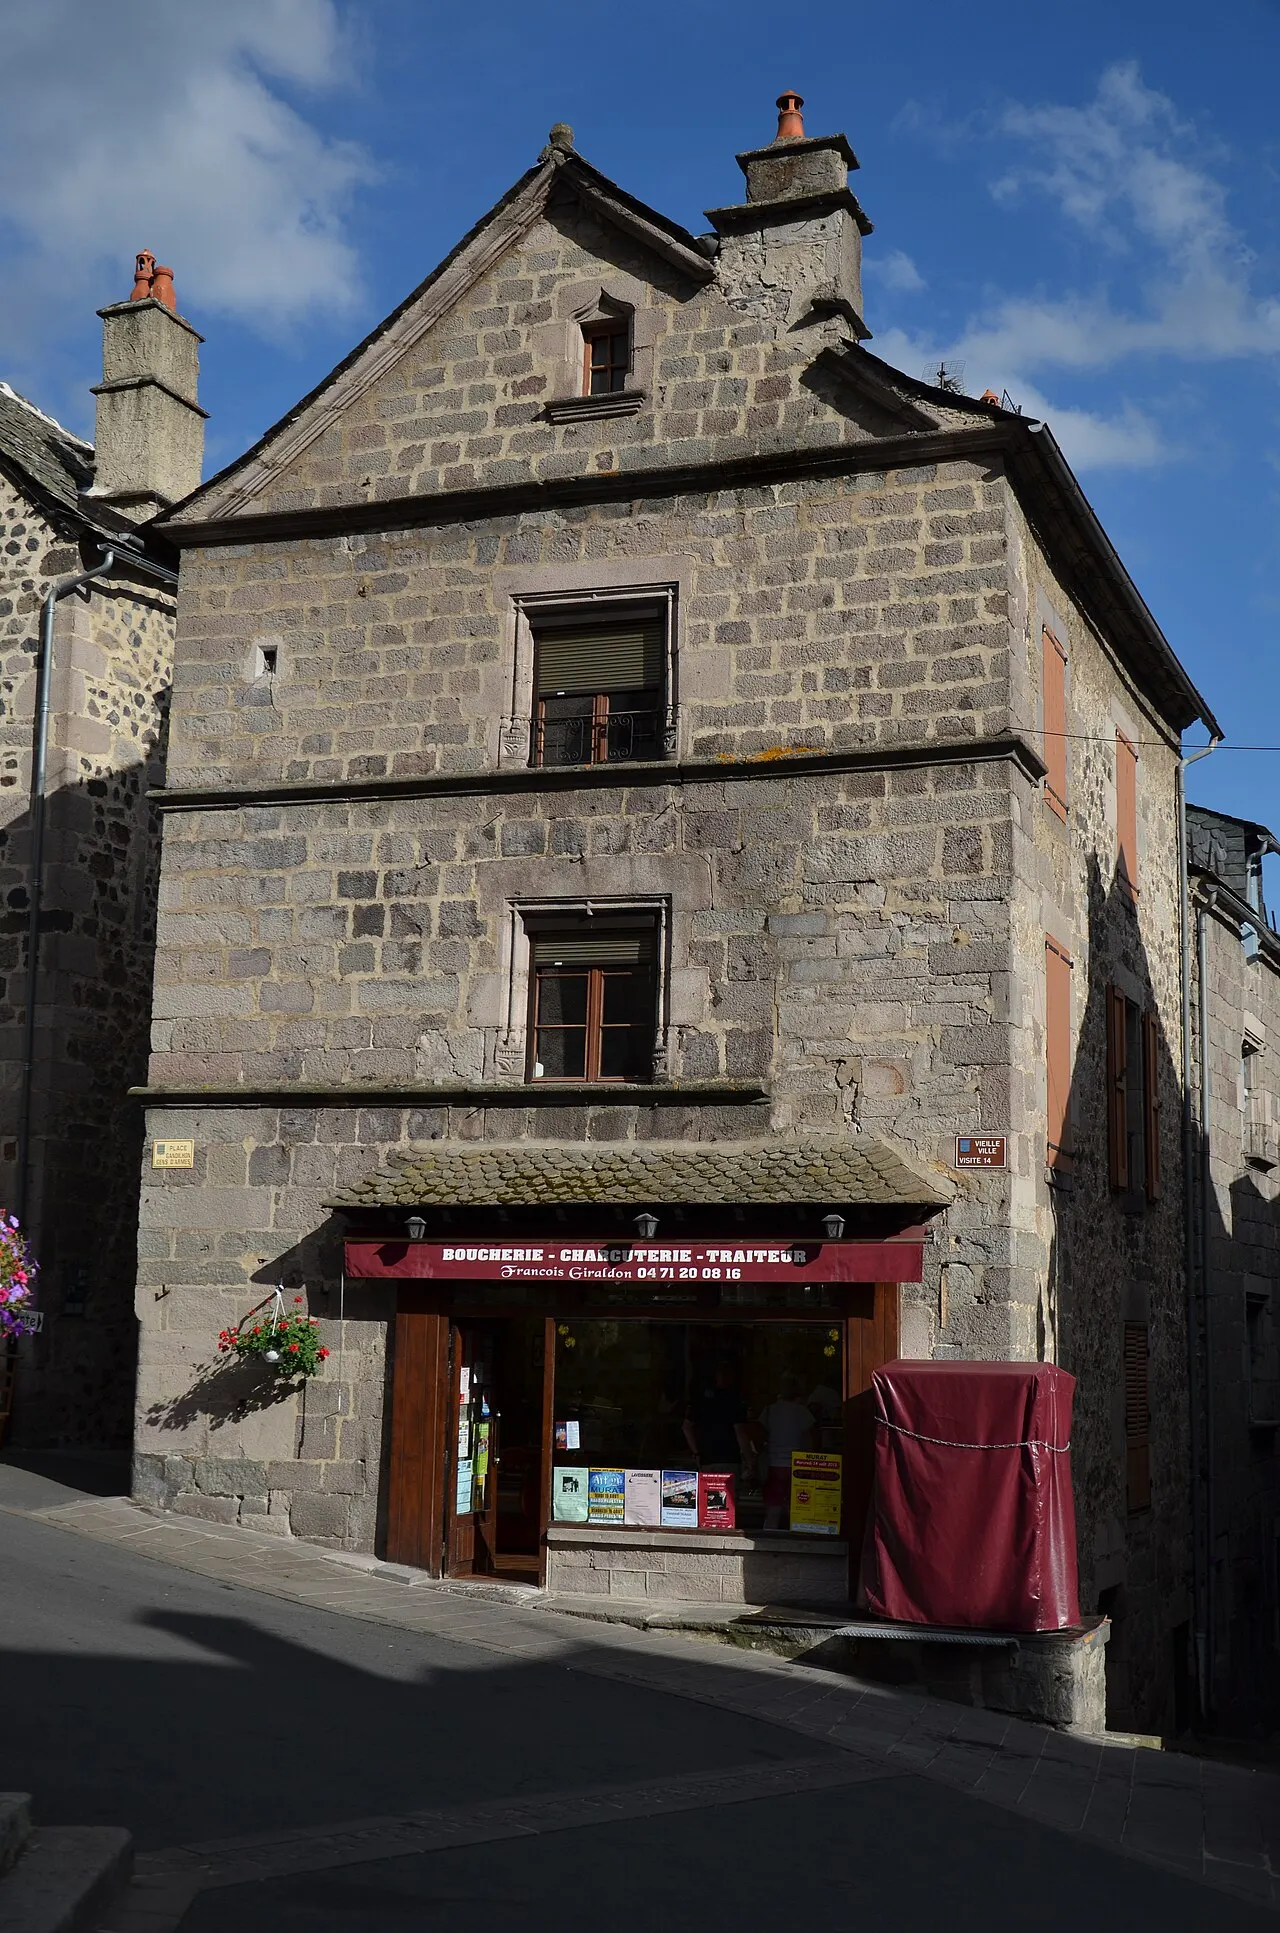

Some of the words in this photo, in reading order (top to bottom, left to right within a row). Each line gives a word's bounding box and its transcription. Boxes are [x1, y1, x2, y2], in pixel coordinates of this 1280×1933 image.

[443, 1248, 543, 1261] BOUCHERIE
[560, 1249, 692, 1262] CHARCUTERIE
[706, 1249, 806, 1263] TRAITEUR
[500, 1265, 564, 1278] Francois
[568, 1266, 632, 1279] Giraldon
[637, 1267, 656, 1279] 04
[660, 1267, 674, 1279] 71
[679, 1267, 697, 1279] 20
[701, 1268, 721, 1279] 08
[725, 1268, 741, 1280] 16
